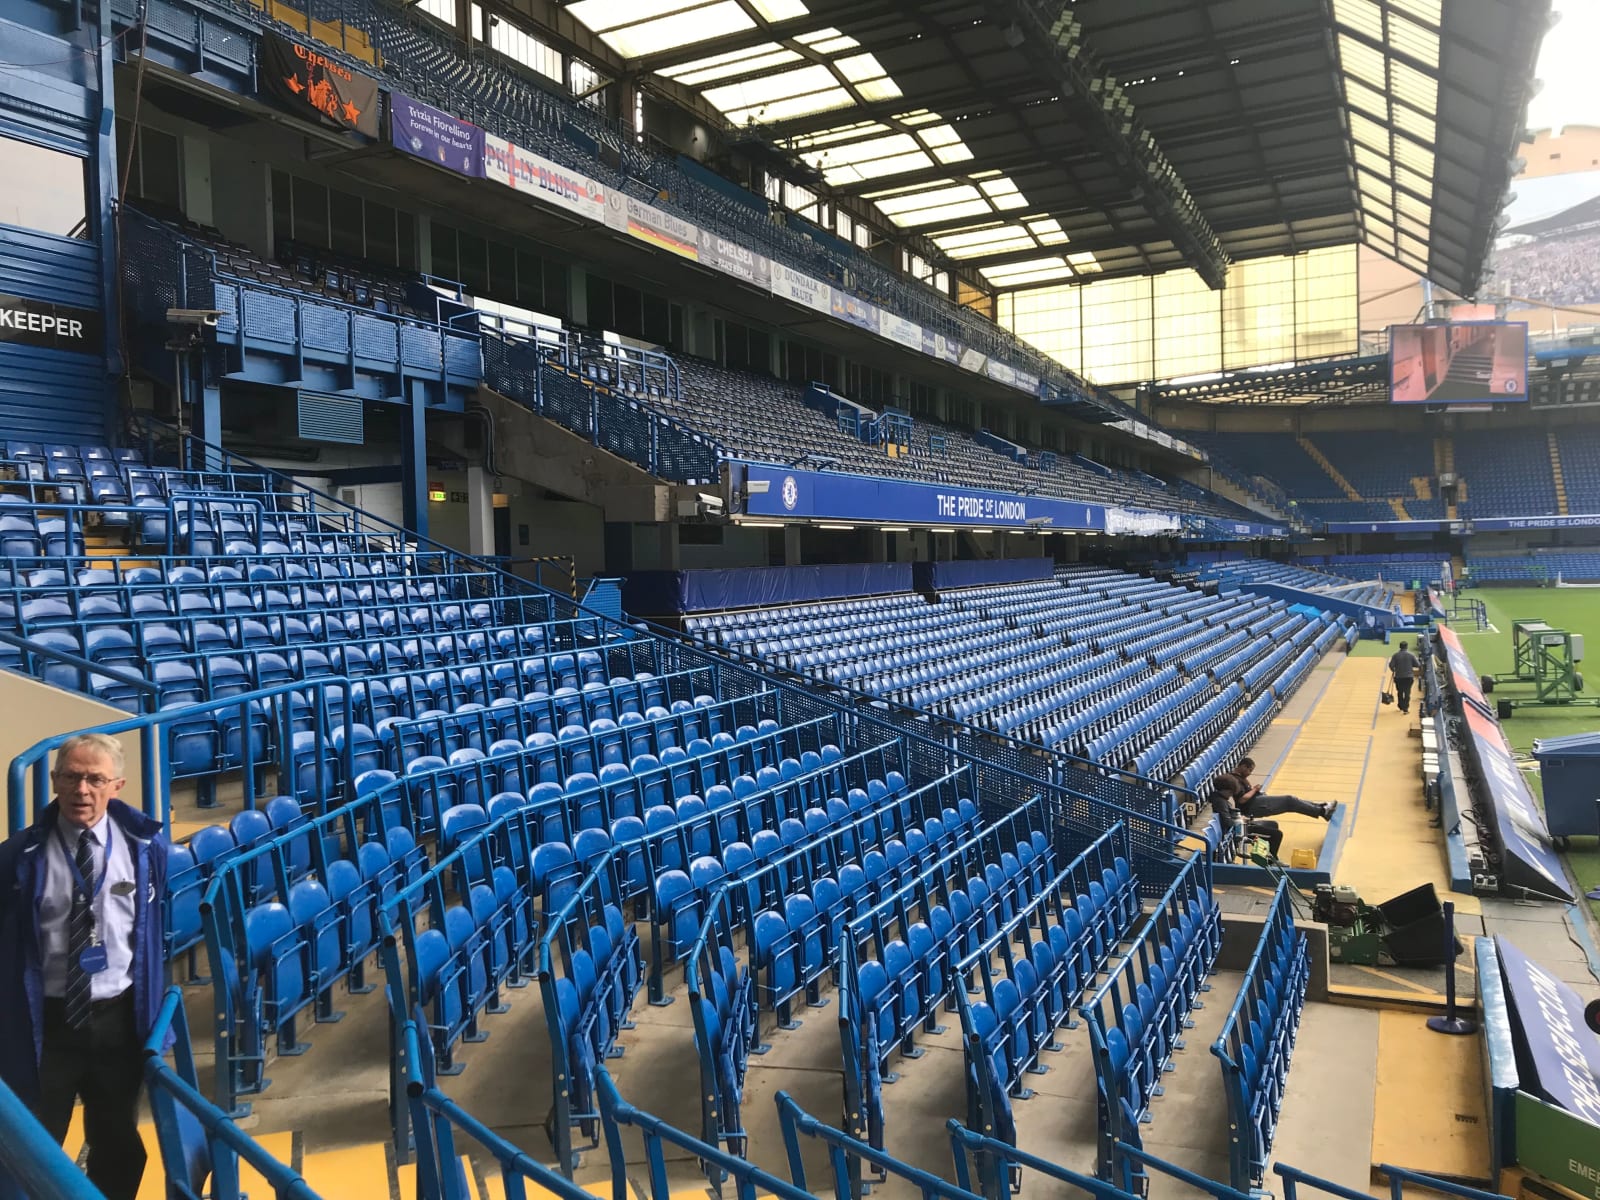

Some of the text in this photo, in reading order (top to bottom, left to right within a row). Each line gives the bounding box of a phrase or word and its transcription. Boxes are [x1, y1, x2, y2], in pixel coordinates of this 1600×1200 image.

[539, 166, 579, 202] BLUES
[627, 197, 687, 237] German Blues
[717, 239, 754, 266] CHELSEA
[0, 308, 83, 339] KEEPER
[937, 494, 1026, 521] THE PRIDE OF LONDON
[1508, 520, 1525, 528] THE
[1528, 519, 1555, 527] PRIDE
